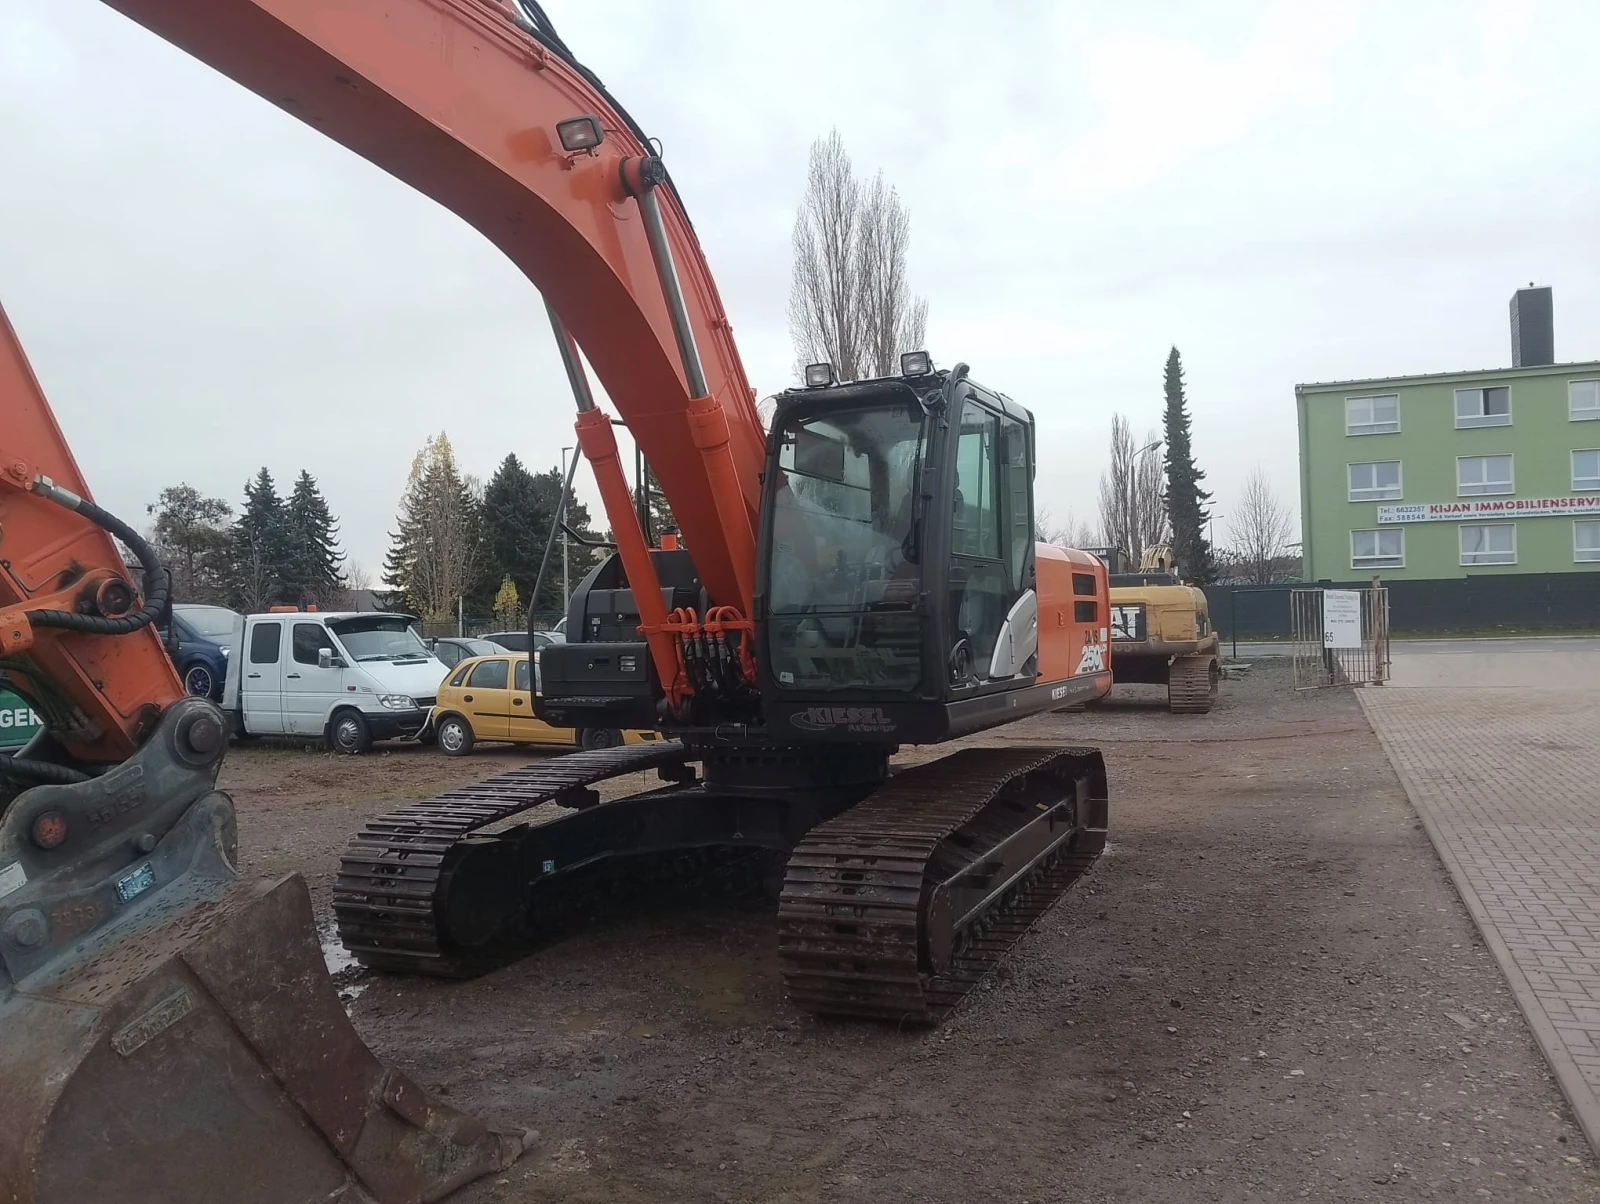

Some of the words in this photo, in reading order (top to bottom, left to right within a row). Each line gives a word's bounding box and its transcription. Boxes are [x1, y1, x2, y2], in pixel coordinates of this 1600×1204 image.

[1430, 503, 1471, 513] KIJAN
[1325, 632, 1334, 642] 65
[1082, 645, 1101, 673] 250
[807, 707, 892, 724] KIESEL
